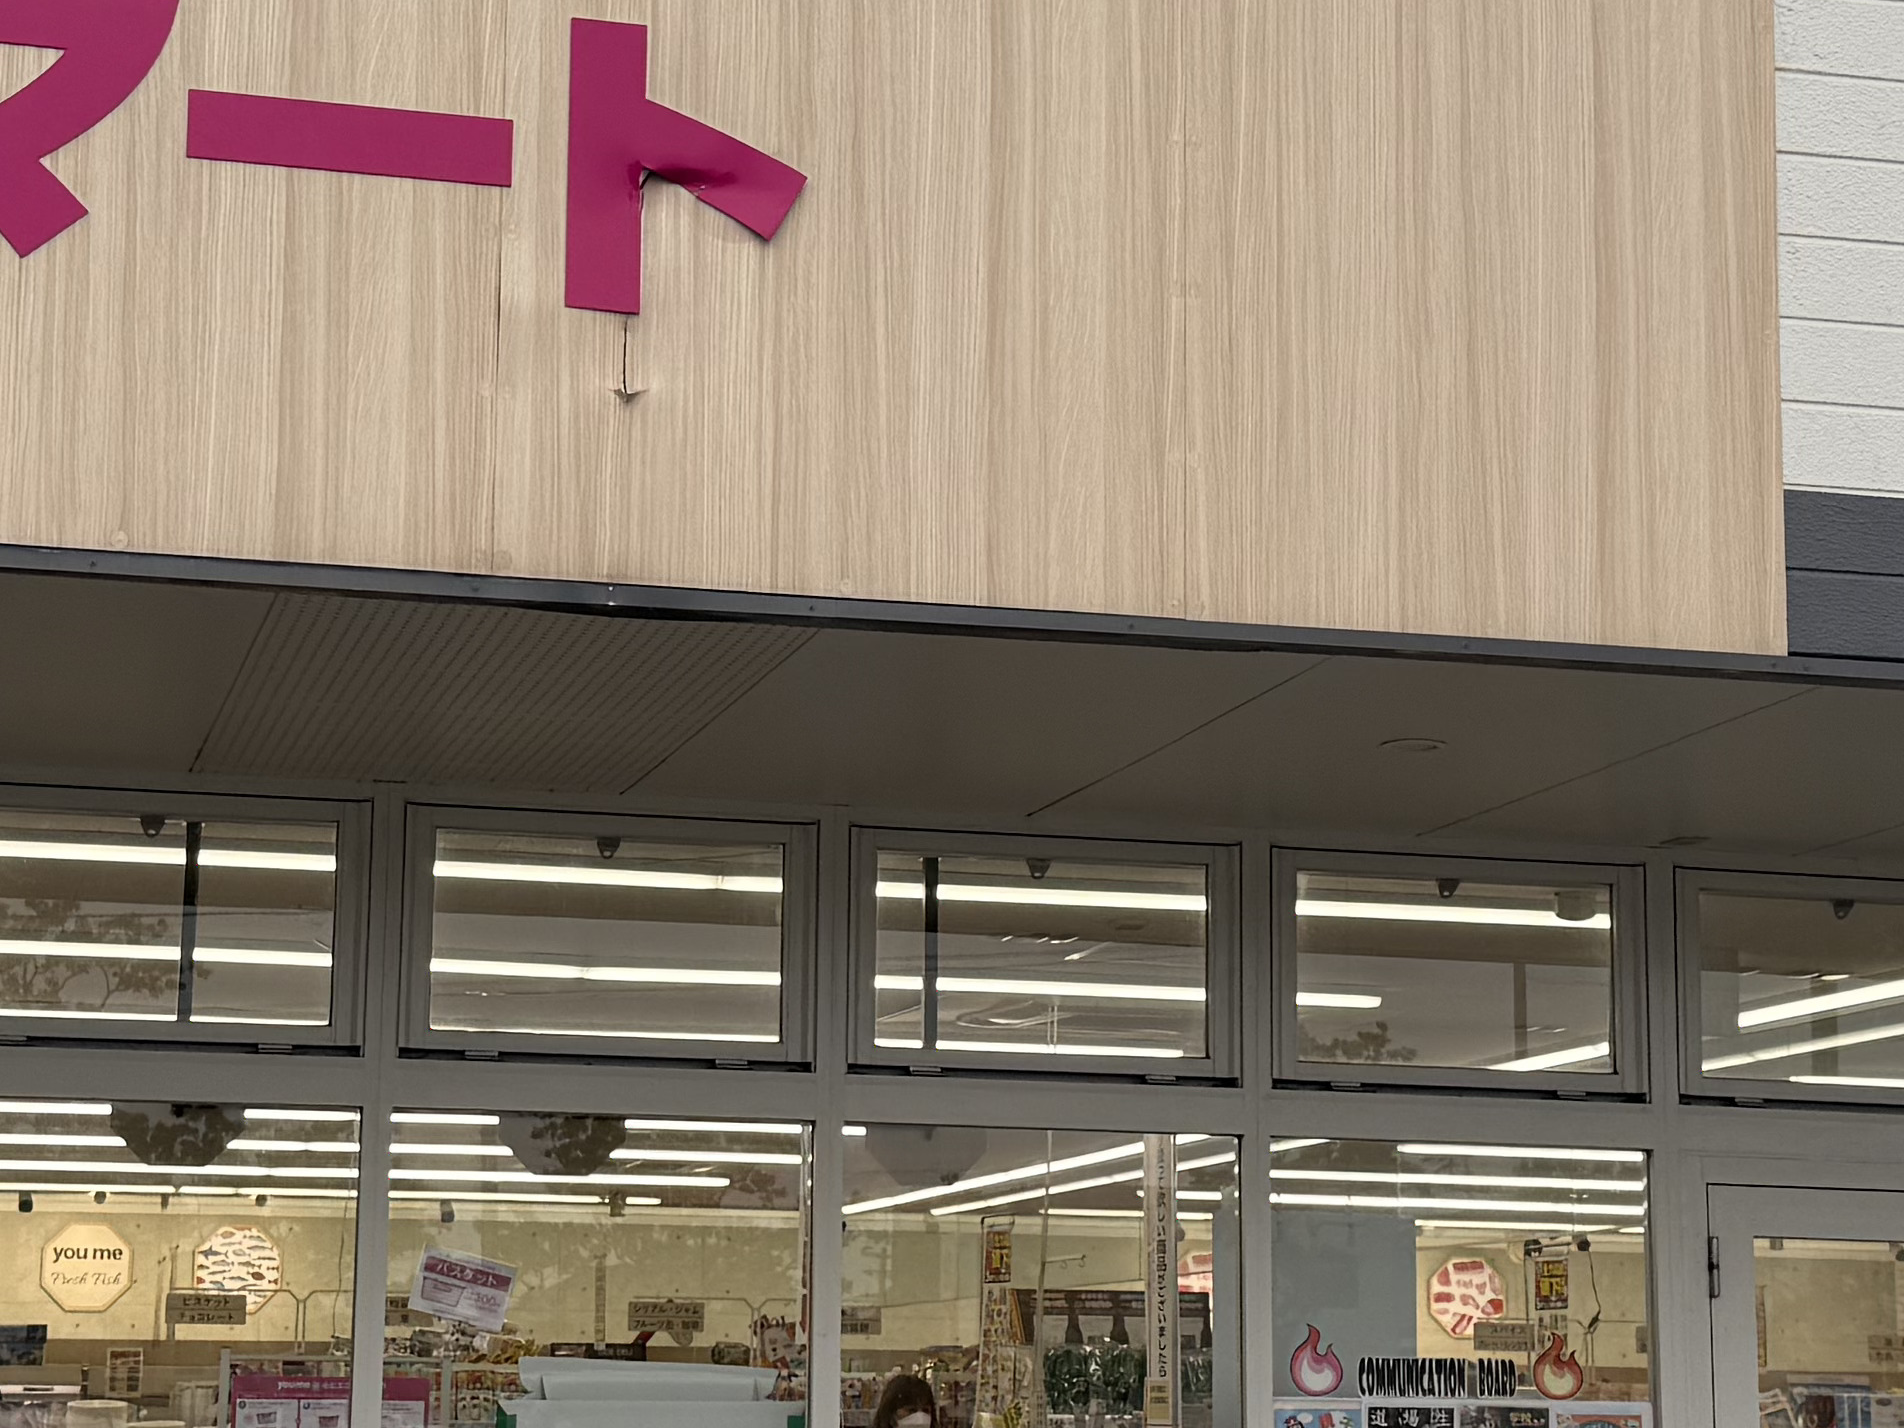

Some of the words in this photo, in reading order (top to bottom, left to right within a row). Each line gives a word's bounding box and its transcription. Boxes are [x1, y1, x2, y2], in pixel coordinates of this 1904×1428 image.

[179, 1312, 234, 1322] チョコレート
[1358, 1357, 1467, 1398] COMMUNICATION
[1477, 1358, 1517, 1398] BOARD
